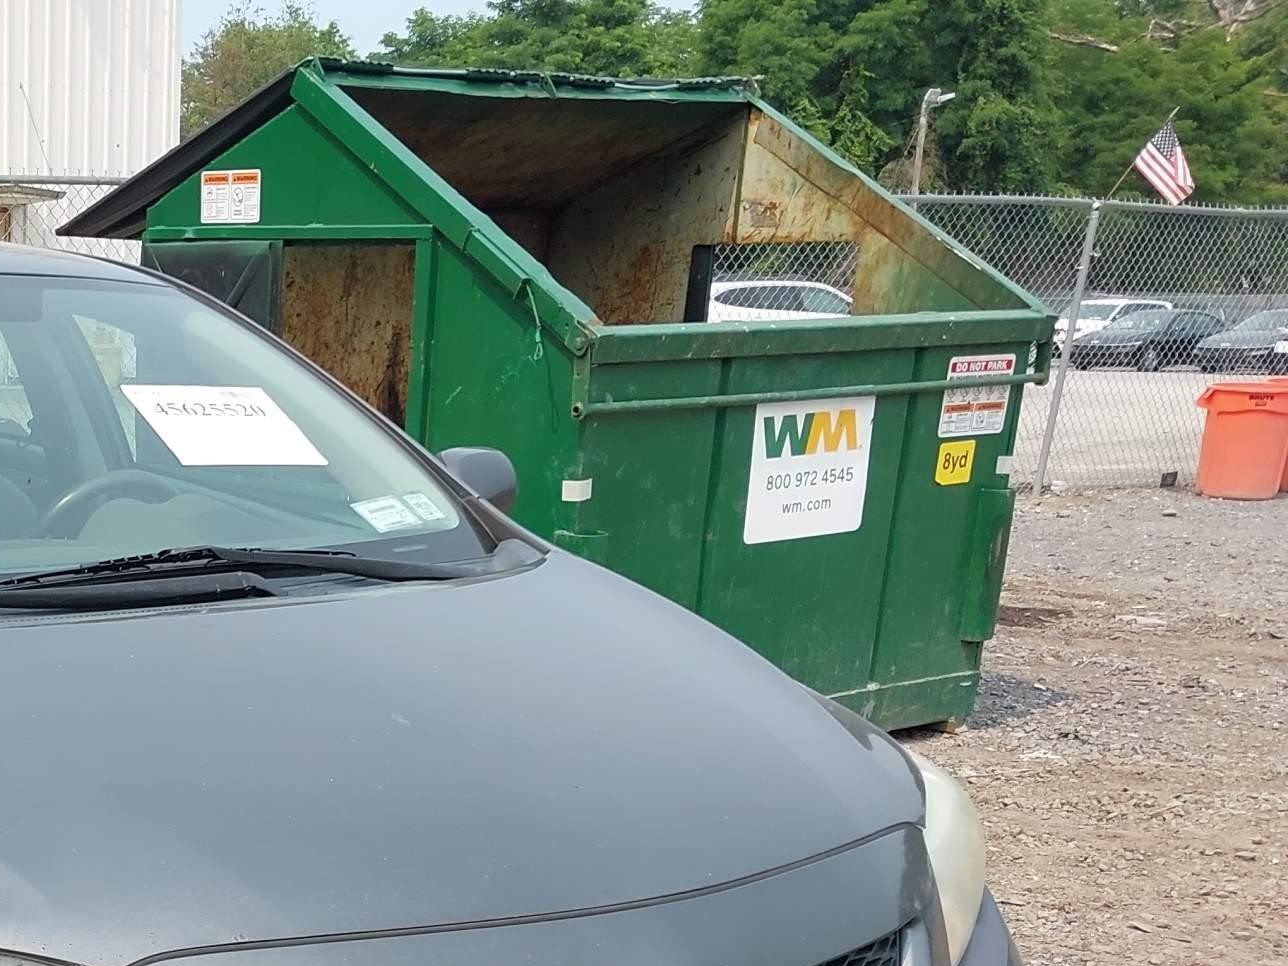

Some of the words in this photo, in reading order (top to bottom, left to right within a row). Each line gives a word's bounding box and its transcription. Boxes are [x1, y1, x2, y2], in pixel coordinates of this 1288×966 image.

[955, 362, 969, 372] DO
[970, 361, 987, 371] NOT
[987, 360, 1009, 370] PARK
[152, 402, 267, 416] 45625520
[763, 408, 858, 459] WM
[942, 450, 969, 474] 8yd
[766, 473, 792, 491] 800
[795, 470, 818, 488] 972
[821, 466, 854, 485] 4545
[781, 498, 832, 514] wm.com
